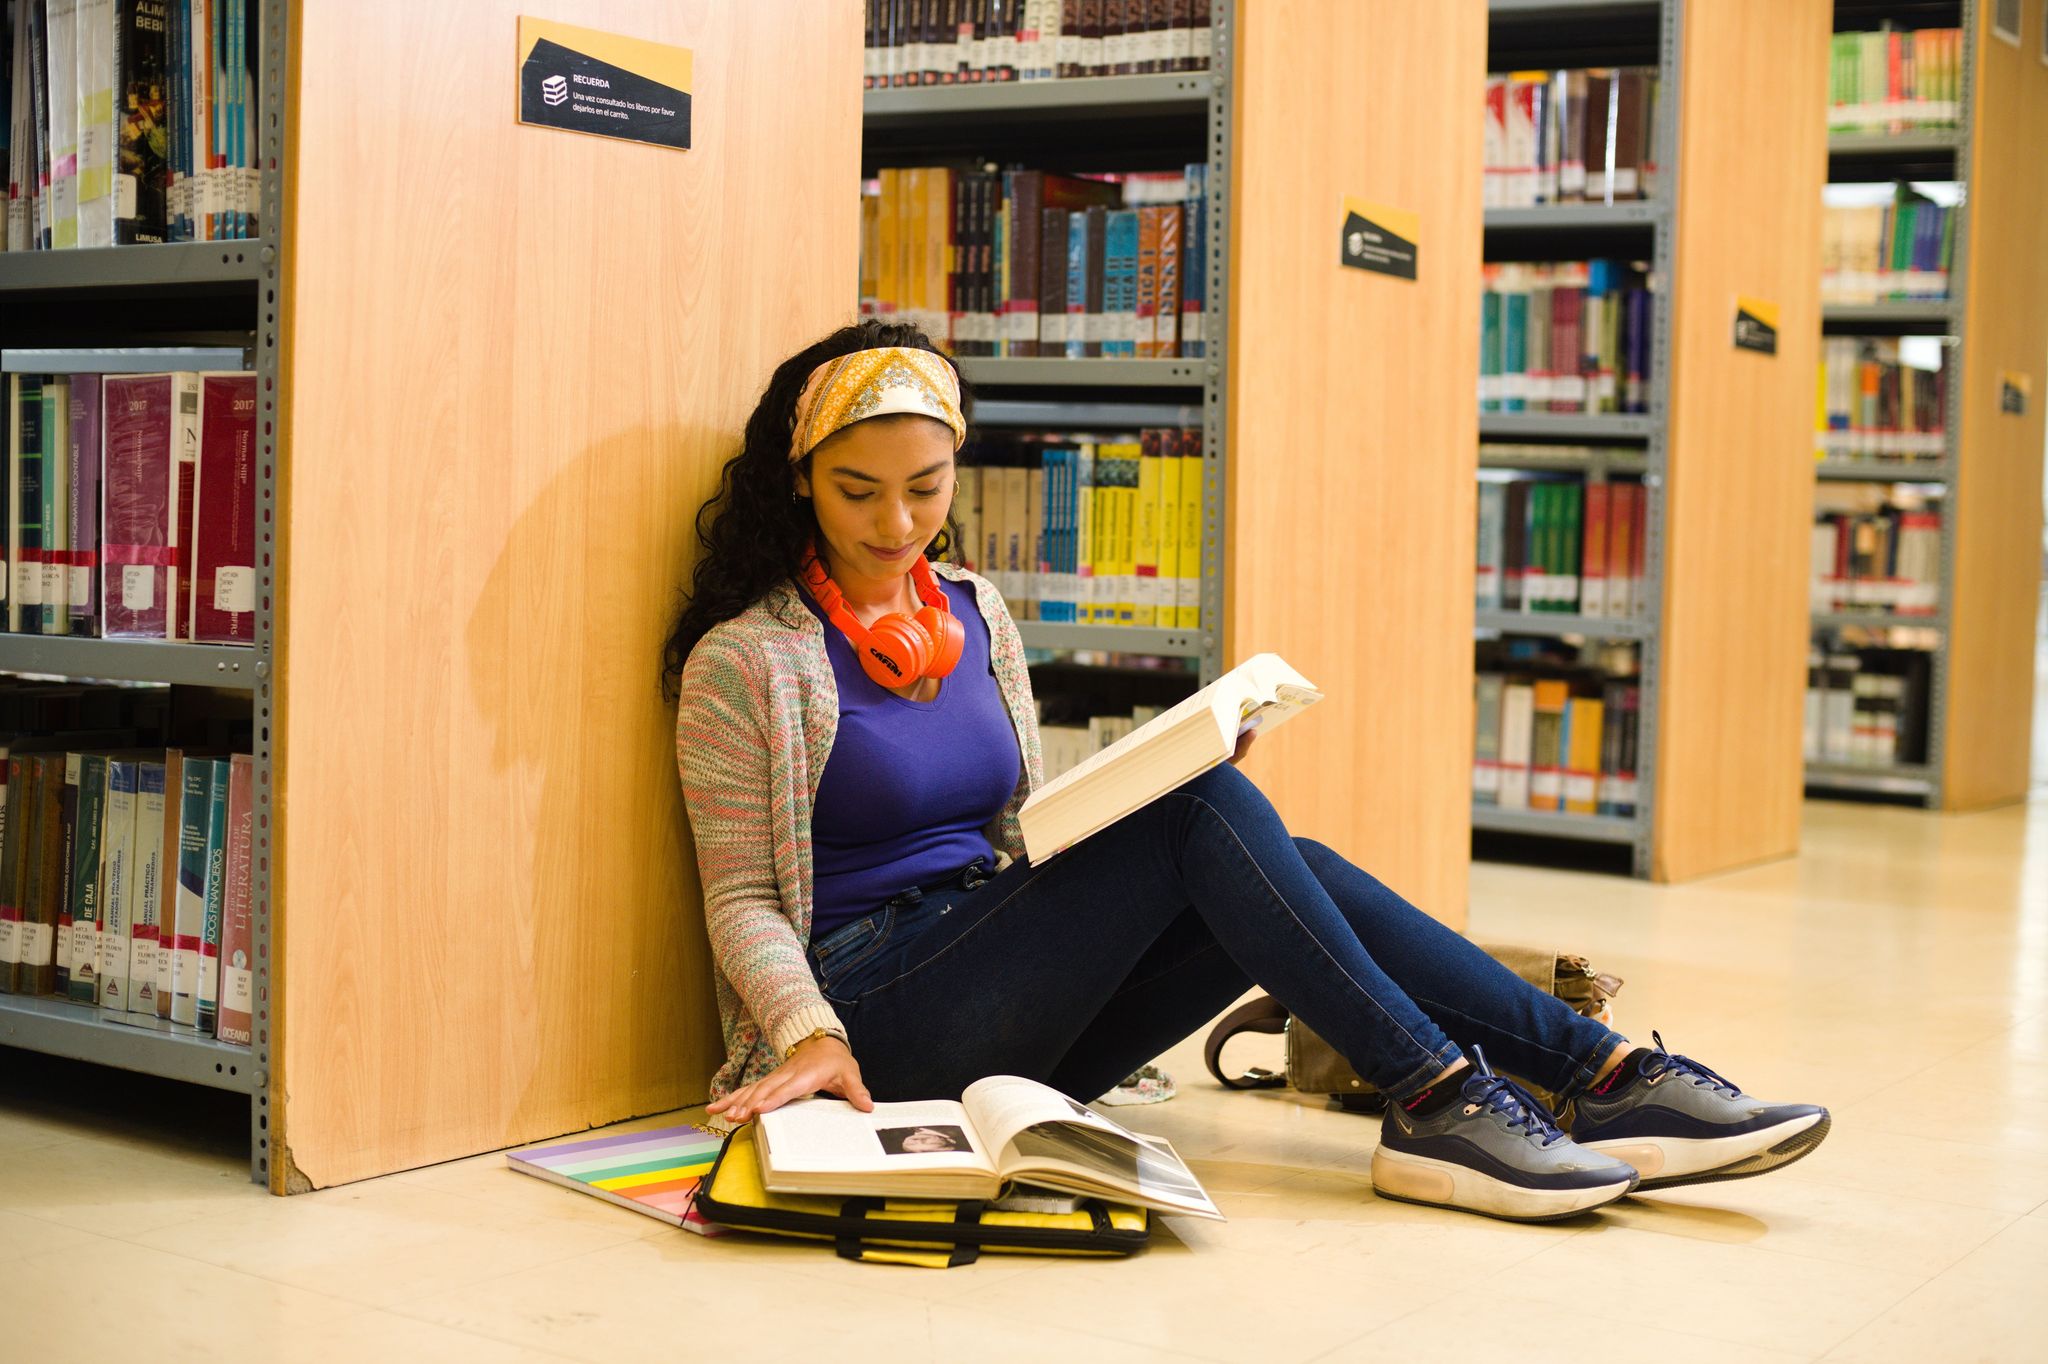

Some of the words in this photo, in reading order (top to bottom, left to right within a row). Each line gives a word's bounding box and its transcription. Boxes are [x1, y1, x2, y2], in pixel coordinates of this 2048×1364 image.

[573, 74, 610, 88] RECUERDA
[573, 92, 584, 102] Una
[585, 94, 595, 102] vez
[596, 95, 626, 109] consultado
[627, 101, 635, 110] los
[636, 102, 650, 112] libros
[651, 106, 660, 115] por
[661, 107, 675, 117] favor
[573, 104, 595, 114] dejarlos
[610, 110, 629, 120] carrito.
[129, 400, 147, 412] 2017
[233, 400, 254, 411] 2017
[229, 842, 239, 912] DICCIONARIO
[234, 826, 240, 839] DE
[235, 812, 251, 929] LITERATURA
[208, 848, 222, 913] FINANCIEROS
[85, 884, 94, 905] CAJA
[85, 907, 92, 918] DE
[207, 915, 217, 944] ADOS
[223, 1026, 250, 1042] OCEANO
